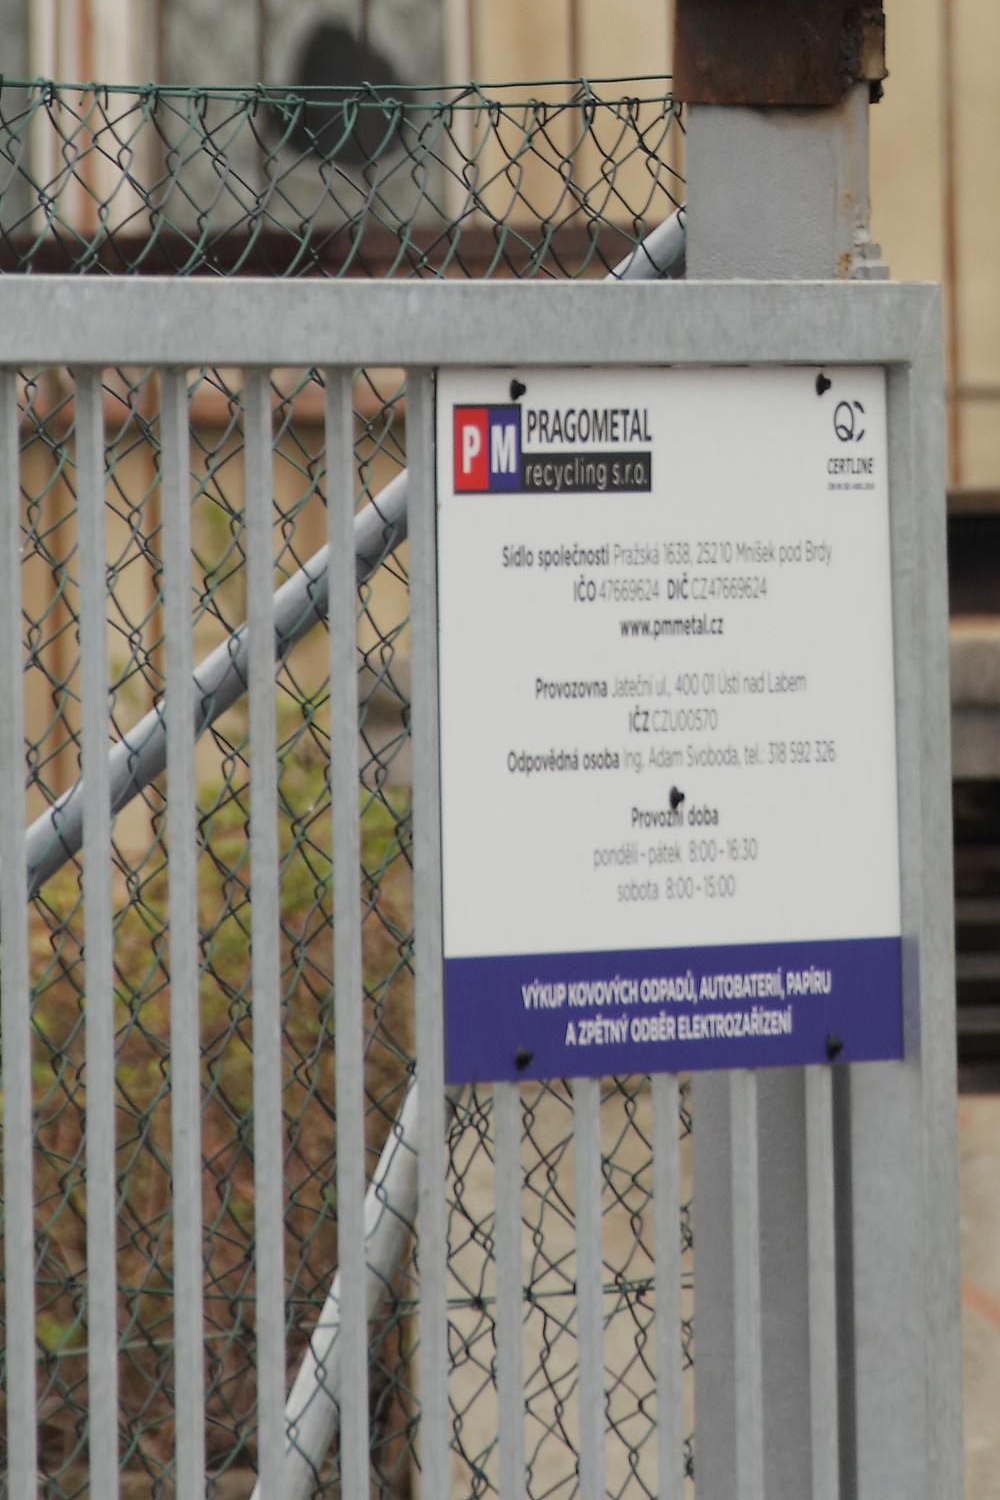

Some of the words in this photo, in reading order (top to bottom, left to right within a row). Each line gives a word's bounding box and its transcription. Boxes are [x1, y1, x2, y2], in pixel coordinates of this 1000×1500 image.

[526, 408, 652, 443] PRAGOMETAL
[525, 456, 607, 490] recycling
[612, 460, 648, 486] s.r.o.
[827, 457, 873, 475] CERTLINE
[502, 545, 533, 568] Sídlo
[538, 543, 610, 571] společnosti
[613, 543, 660, 566] Pražská
[663, 541, 693, 567] 1638,
[779, 541, 802, 567] pod
[805, 539, 832, 566] Brdy
[573, 574, 597, 602] IČO
[599, 579, 659, 601] 47669624
[667, 572, 689, 600] DIČ
[691, 576, 767, 599] CZ47669624
[619, 613, 724, 640] www.pmmetal.cz
[535, 678, 608, 699] Provozovna
[611, 674, 653, 697] Jateční
[675, 673, 699, 695] 400
[702, 673, 715, 695] 01
[743, 671, 764, 693] nad
[768, 670, 807, 693] Labem
[629, 705, 649, 732] IČZ
[507, 748, 579, 776] Odpovědná
[583, 748, 620, 770] osoba
[649, 747, 683, 768] Adam
[686, 744, 741, 767] Svoboda,
[688, 805, 719, 826] doba
[650, 841, 682, 868] pátek
[689, 839, 717, 863] 8:00
[726, 837, 758, 861] 16:30
[617, 879, 659, 901] sobota
[666, 876, 694, 899] 8:00
[704, 874, 735, 898] 15:00
[522, 979, 566, 1009] VÝKUP
[568, 975, 638, 1007] KOVOVÝCH
[640, 970, 698, 1005] ODPADŮ,
[700, 967, 784, 999] AUTOBATERIÍ,
[786, 965, 832, 996] PAPÍRU
[565, 1021, 577, 1046] A
[578, 1014, 628, 1045] ZPĚTNÝ
[630, 1011, 676, 1043] ODBĚR
[677, 1005, 792, 1040] ELEKTROZAŘÍZENÍ
